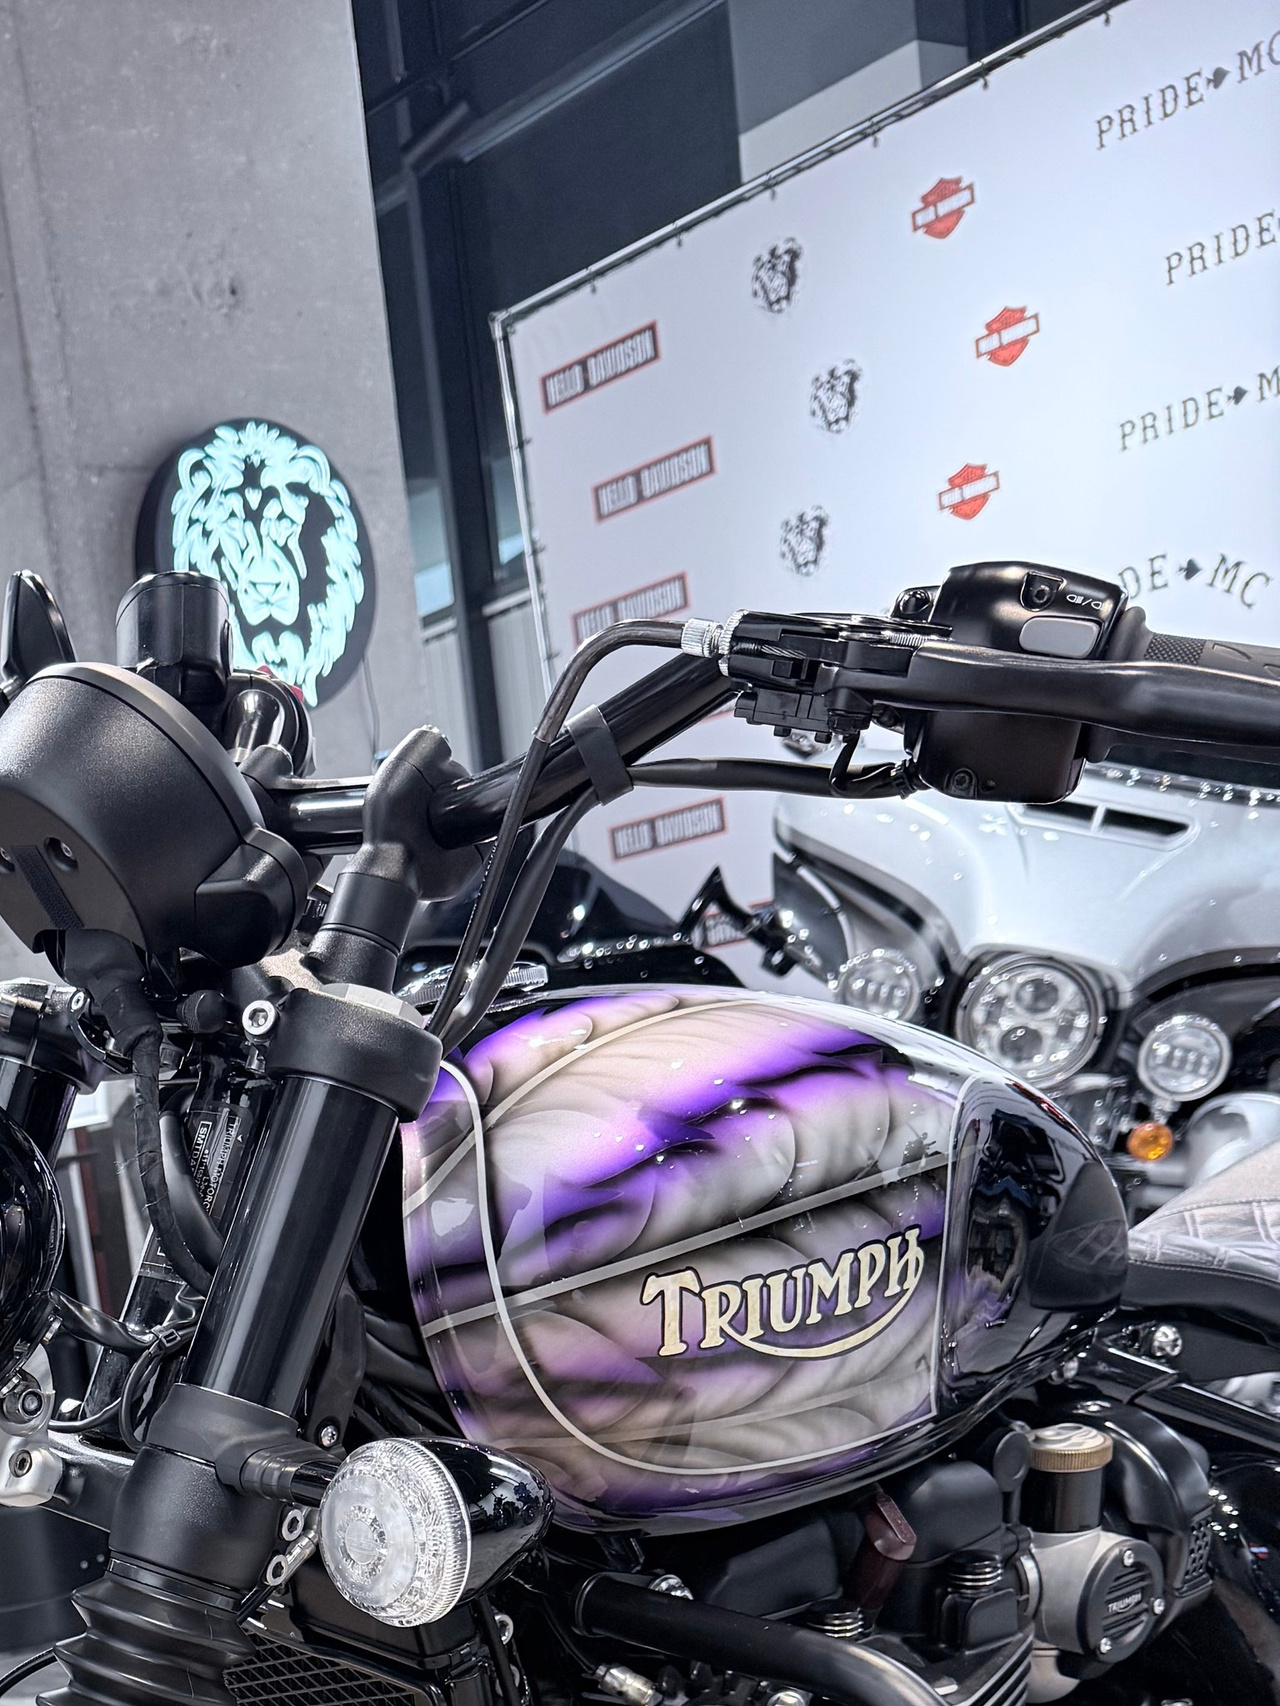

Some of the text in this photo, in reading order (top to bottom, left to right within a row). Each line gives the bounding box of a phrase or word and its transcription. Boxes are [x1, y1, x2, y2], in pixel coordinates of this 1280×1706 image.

[1096, 68, 1204, 150] PRIDE
[1165, 208, 1277, 286] PRIDE
[1119, 387, 1224, 451] PRIDE
[1206, 553, 1275, 609] MC
[641, 1227, 924, 1358] TRIUMPH
[1108, 1591, 1142, 1613] TRIUMPH
